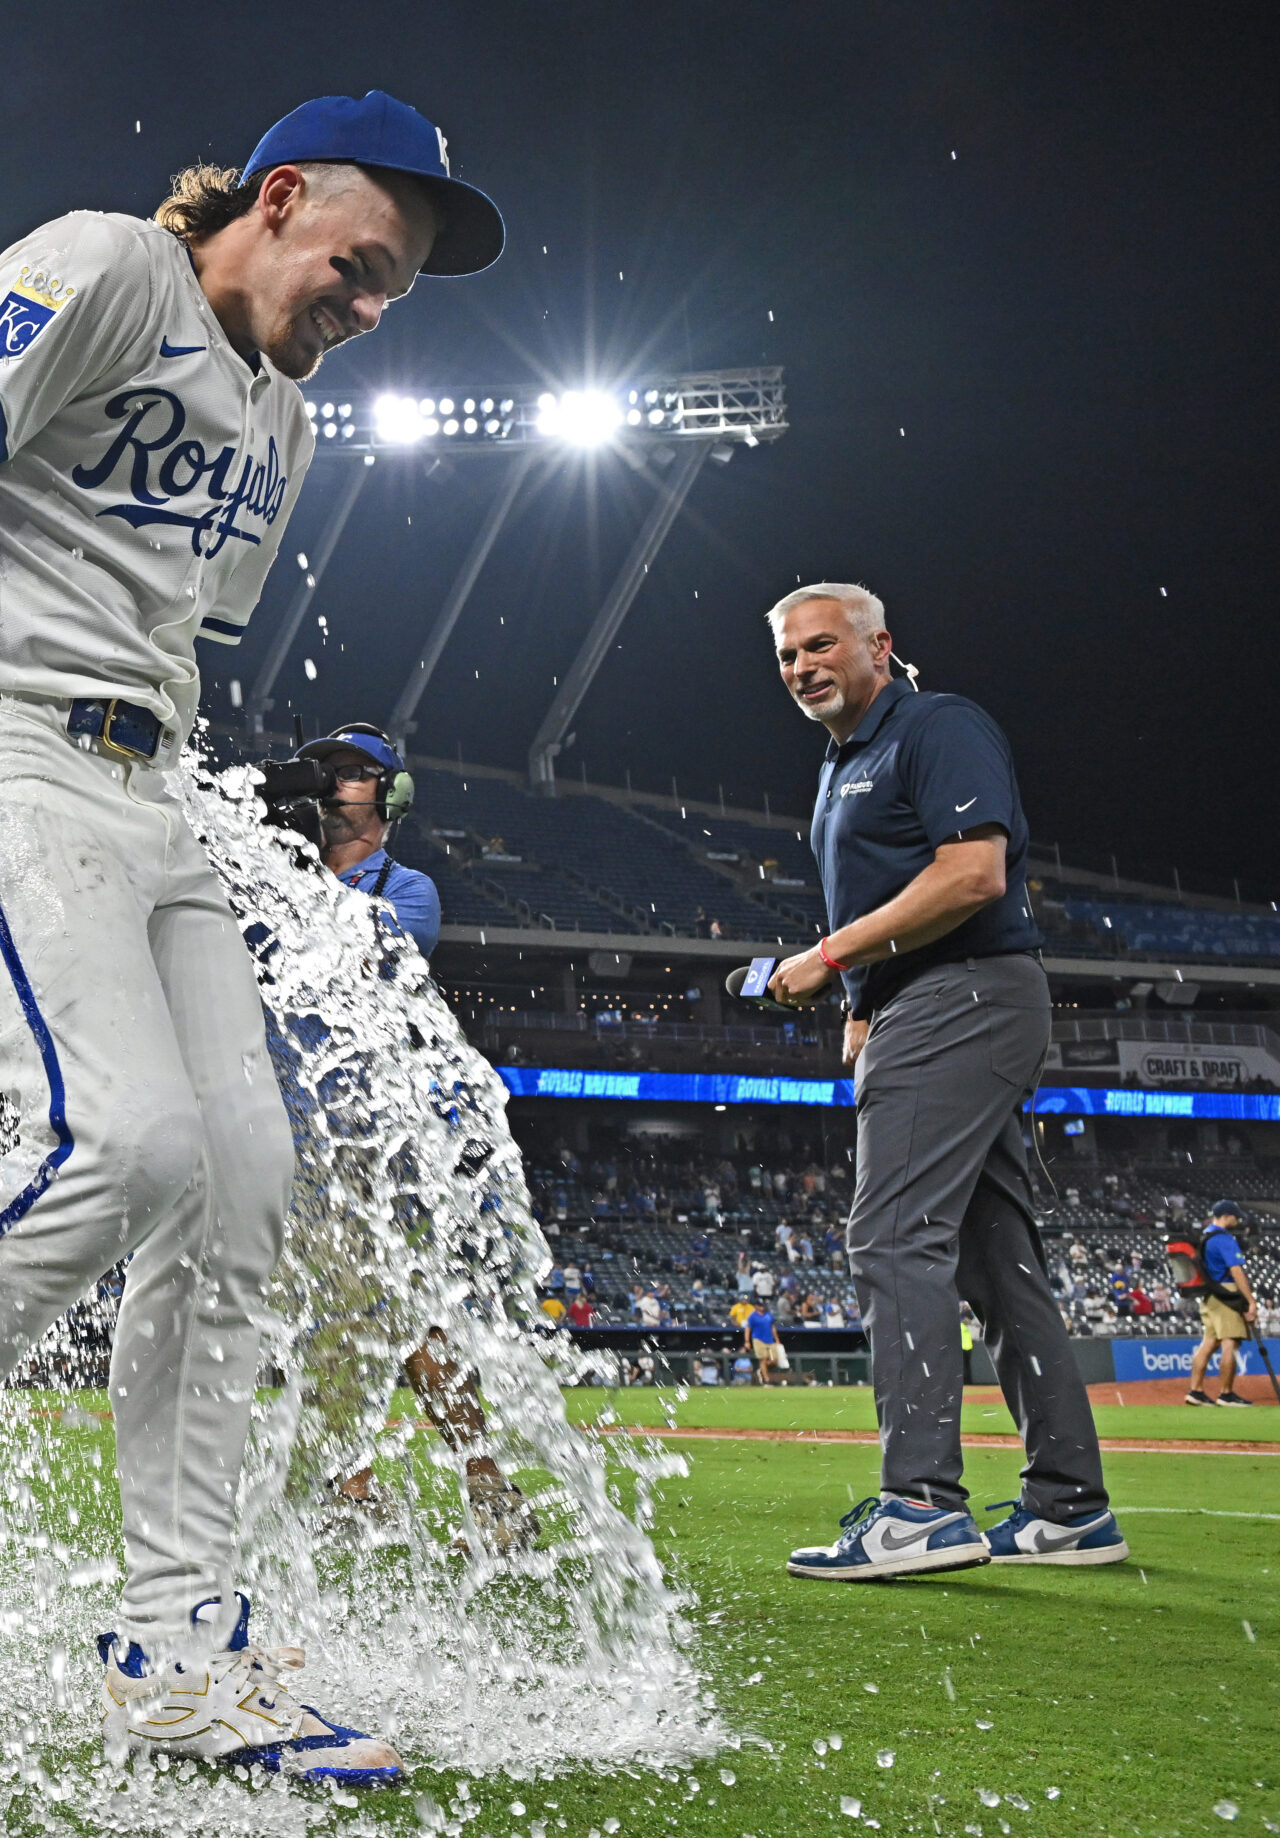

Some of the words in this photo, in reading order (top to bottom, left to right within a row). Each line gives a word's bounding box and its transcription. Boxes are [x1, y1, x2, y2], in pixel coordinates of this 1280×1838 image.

[72, 388, 286, 560] Royals
[1146, 1058, 1187, 1077] CRAFT
[1190, 1060, 1199, 1077] &
[1201, 1060, 1242, 1080] DRAFT
[539, 1071, 584, 1094] ROYALS
[737, 1077, 779, 1100] ROYALS
